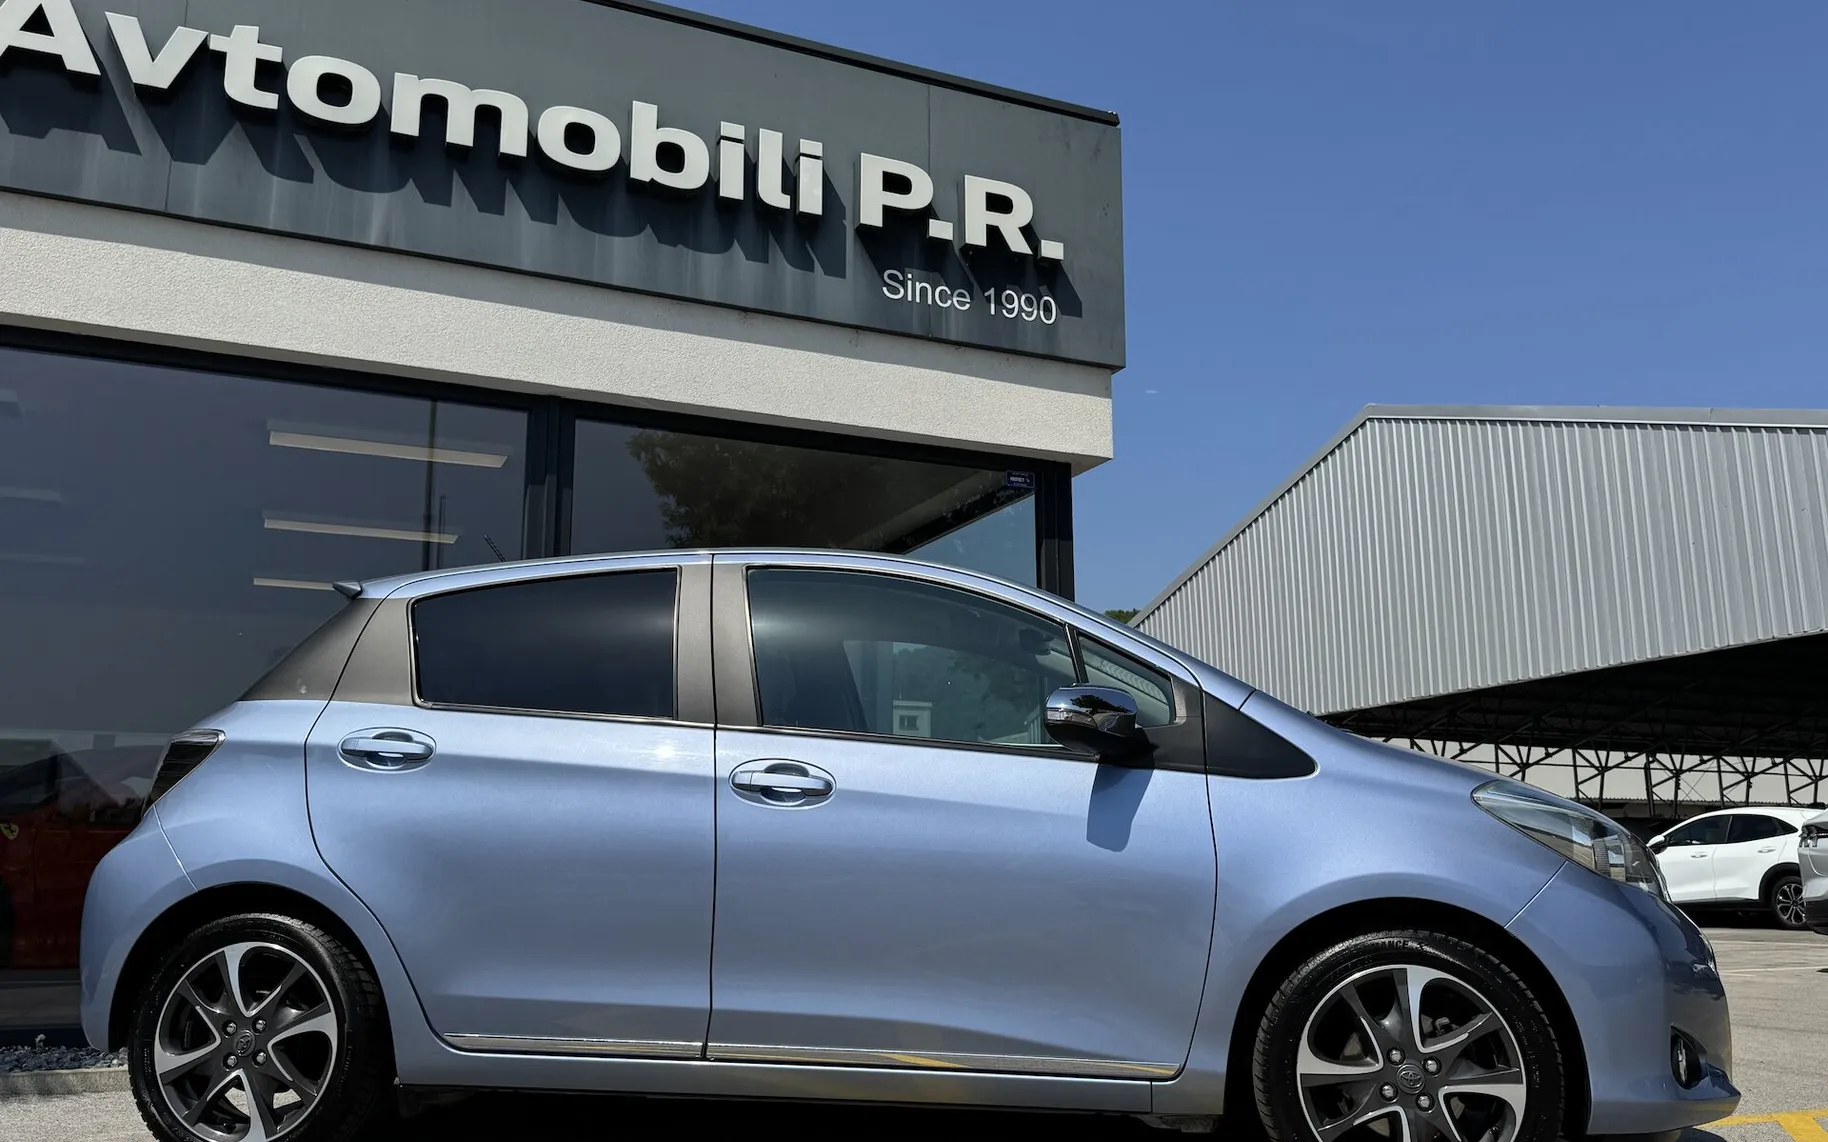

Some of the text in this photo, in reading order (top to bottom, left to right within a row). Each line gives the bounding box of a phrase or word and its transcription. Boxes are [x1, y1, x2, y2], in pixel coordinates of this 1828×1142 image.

[0, 0, 1064, 261] Avtomobili P.R.
[882, 269, 1057, 325] Since 1990
